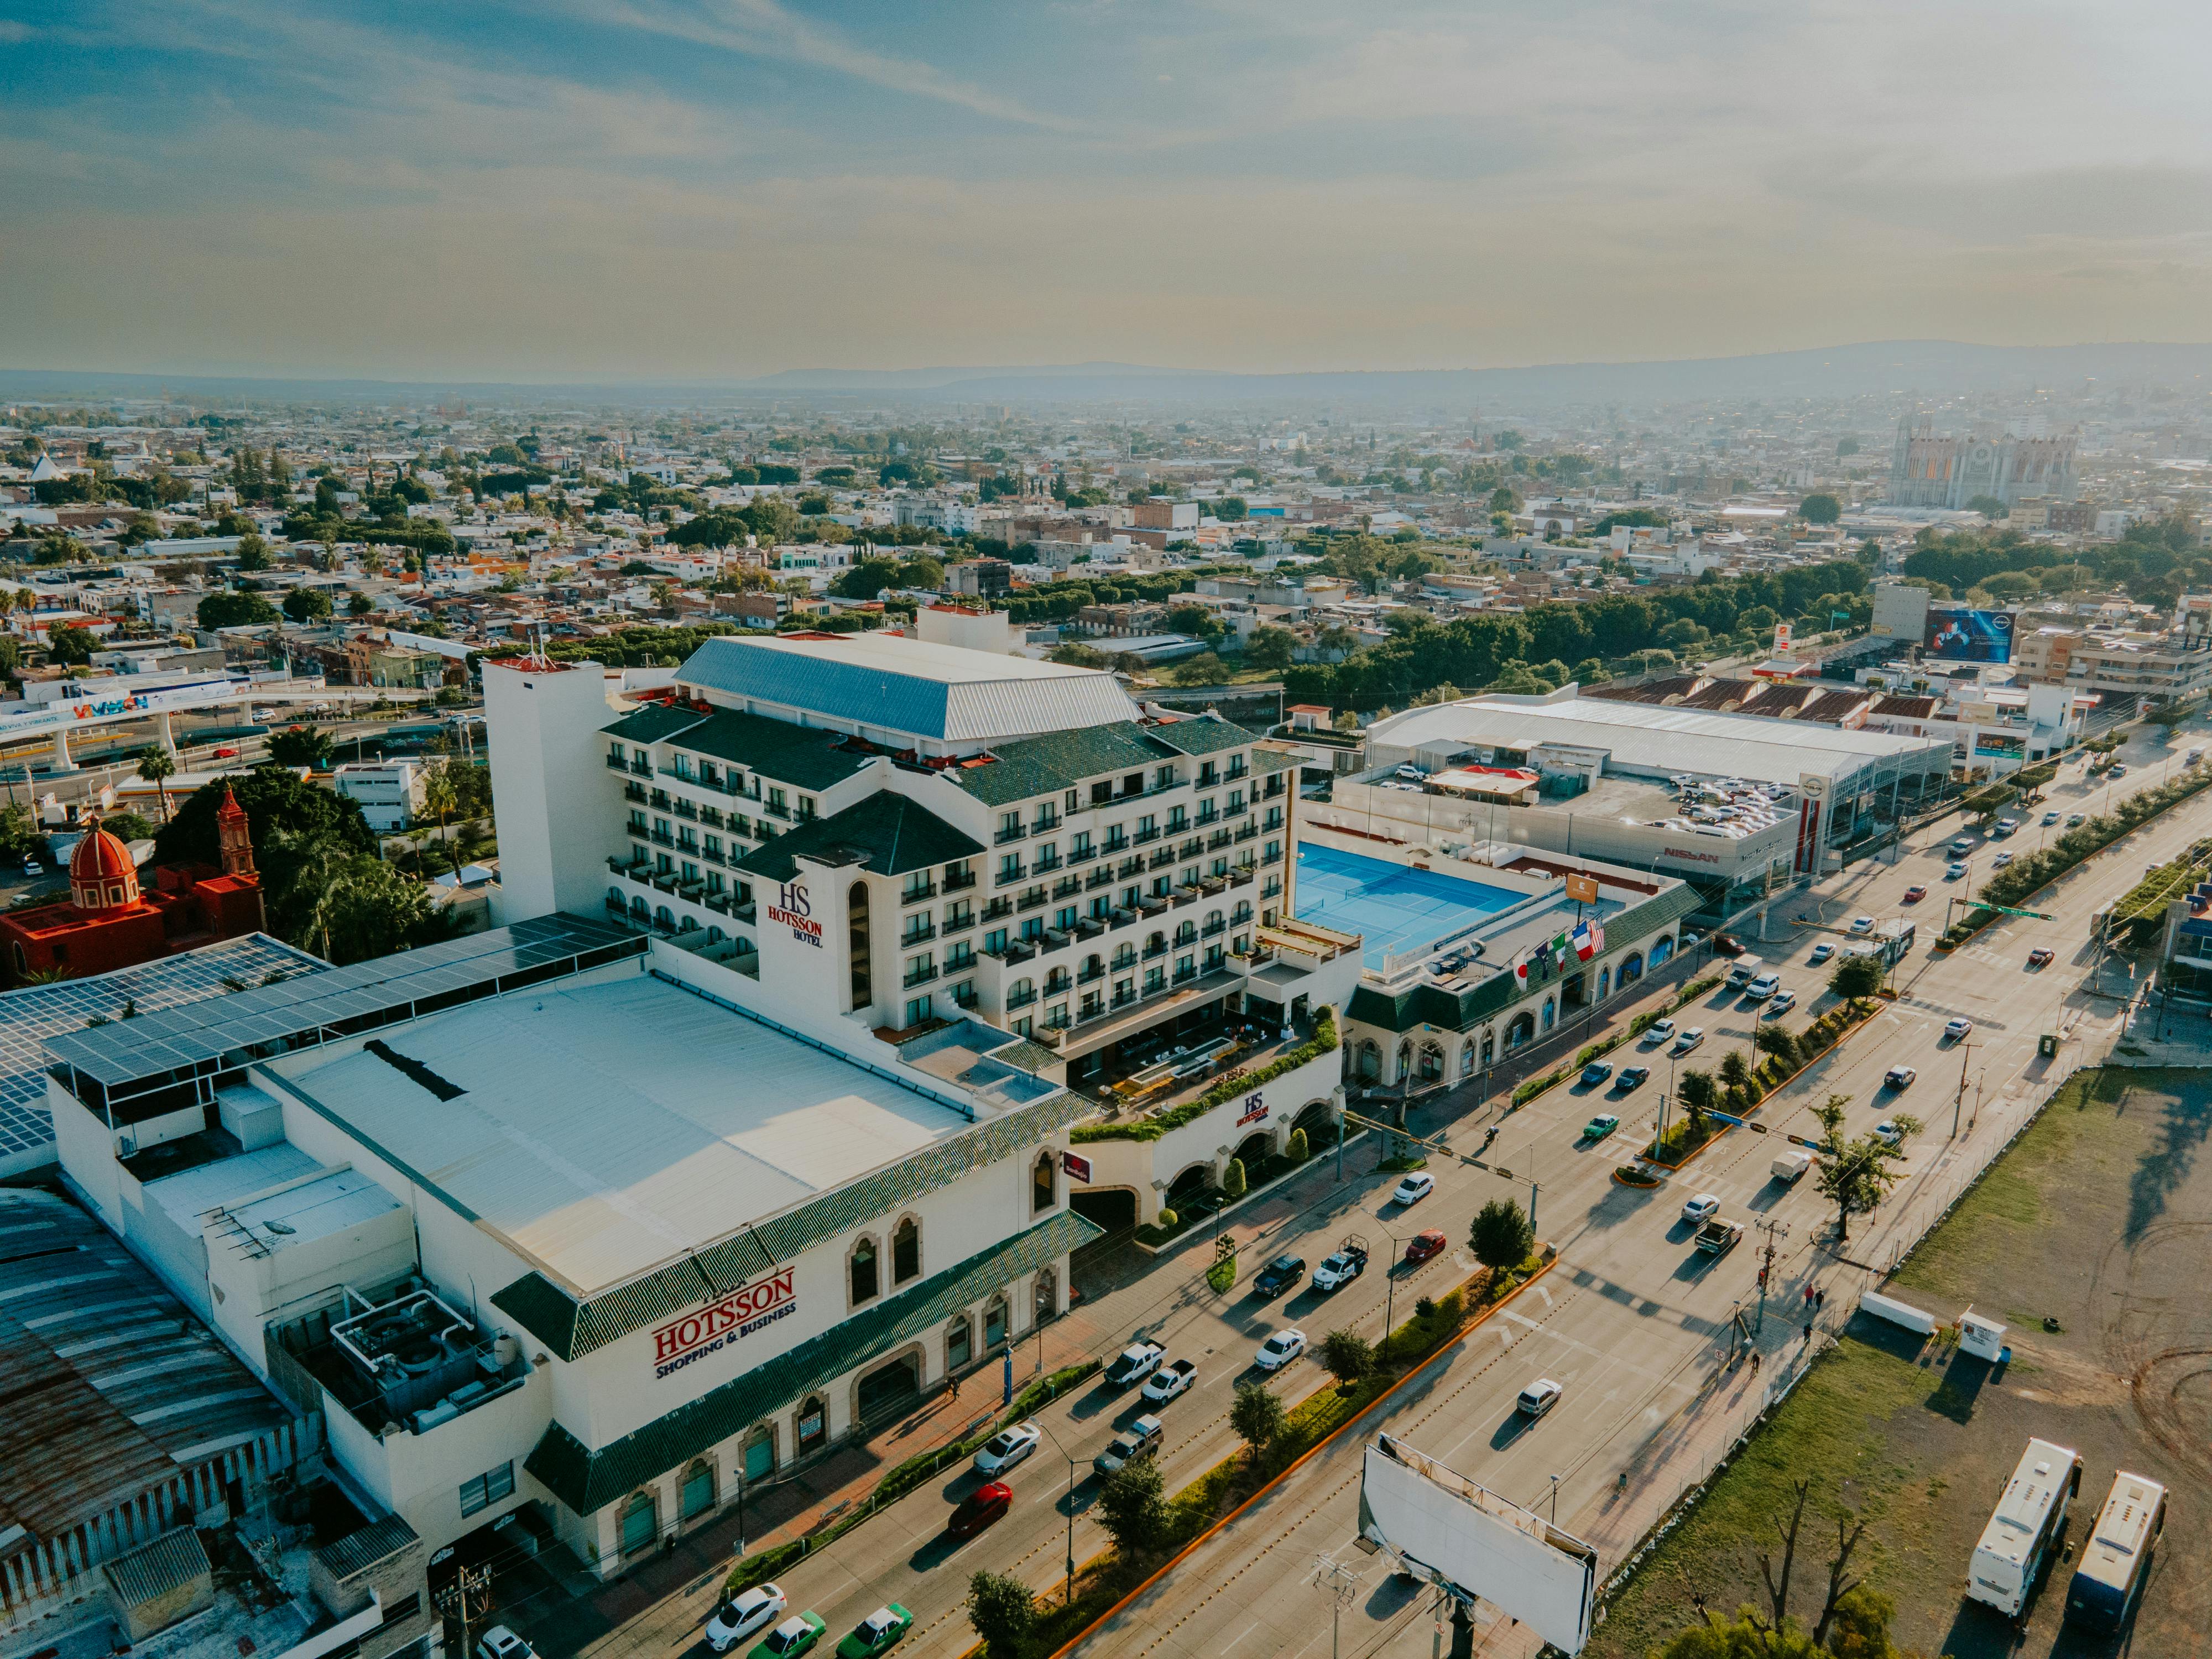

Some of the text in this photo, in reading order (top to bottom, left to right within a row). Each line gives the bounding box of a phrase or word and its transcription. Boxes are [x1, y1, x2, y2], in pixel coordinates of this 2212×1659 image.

[29, 716, 58, 726] VIBRANTE
[1664, 847, 1719, 863] NISSAN
[779, 883, 811, 917] HS
[768, 905, 822, 937] HOTSSON
[793, 928, 823, 948] HOTEL
[1244, 1092, 1262, 1115] HS
[654, 1271, 794, 1360] HOTSSON
[656, 1302, 796, 1379] SHOPPING & BUSINESS
